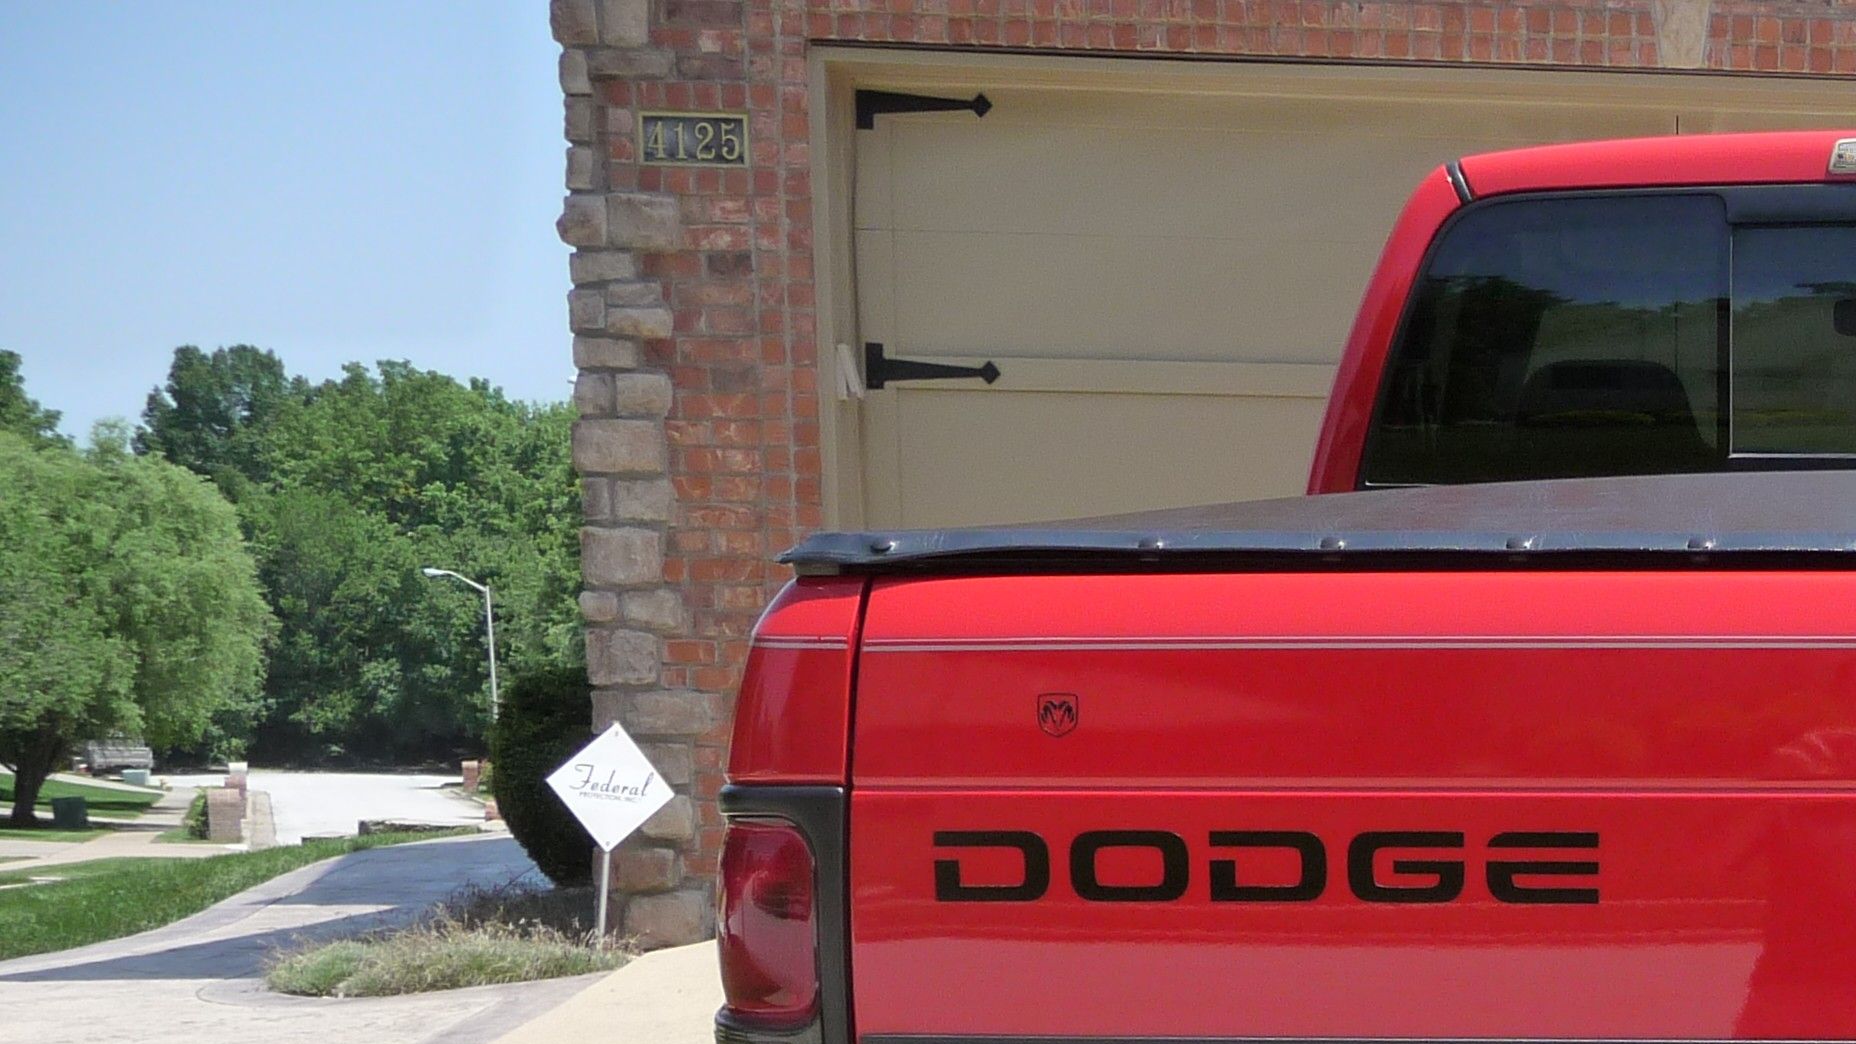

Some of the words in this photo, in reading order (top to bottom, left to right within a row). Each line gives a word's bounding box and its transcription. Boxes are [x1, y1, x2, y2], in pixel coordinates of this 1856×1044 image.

[648, 121, 740, 160] 4125
[569, 763, 654, 797] Federal
[933, 830, 1600, 904] DODGE
